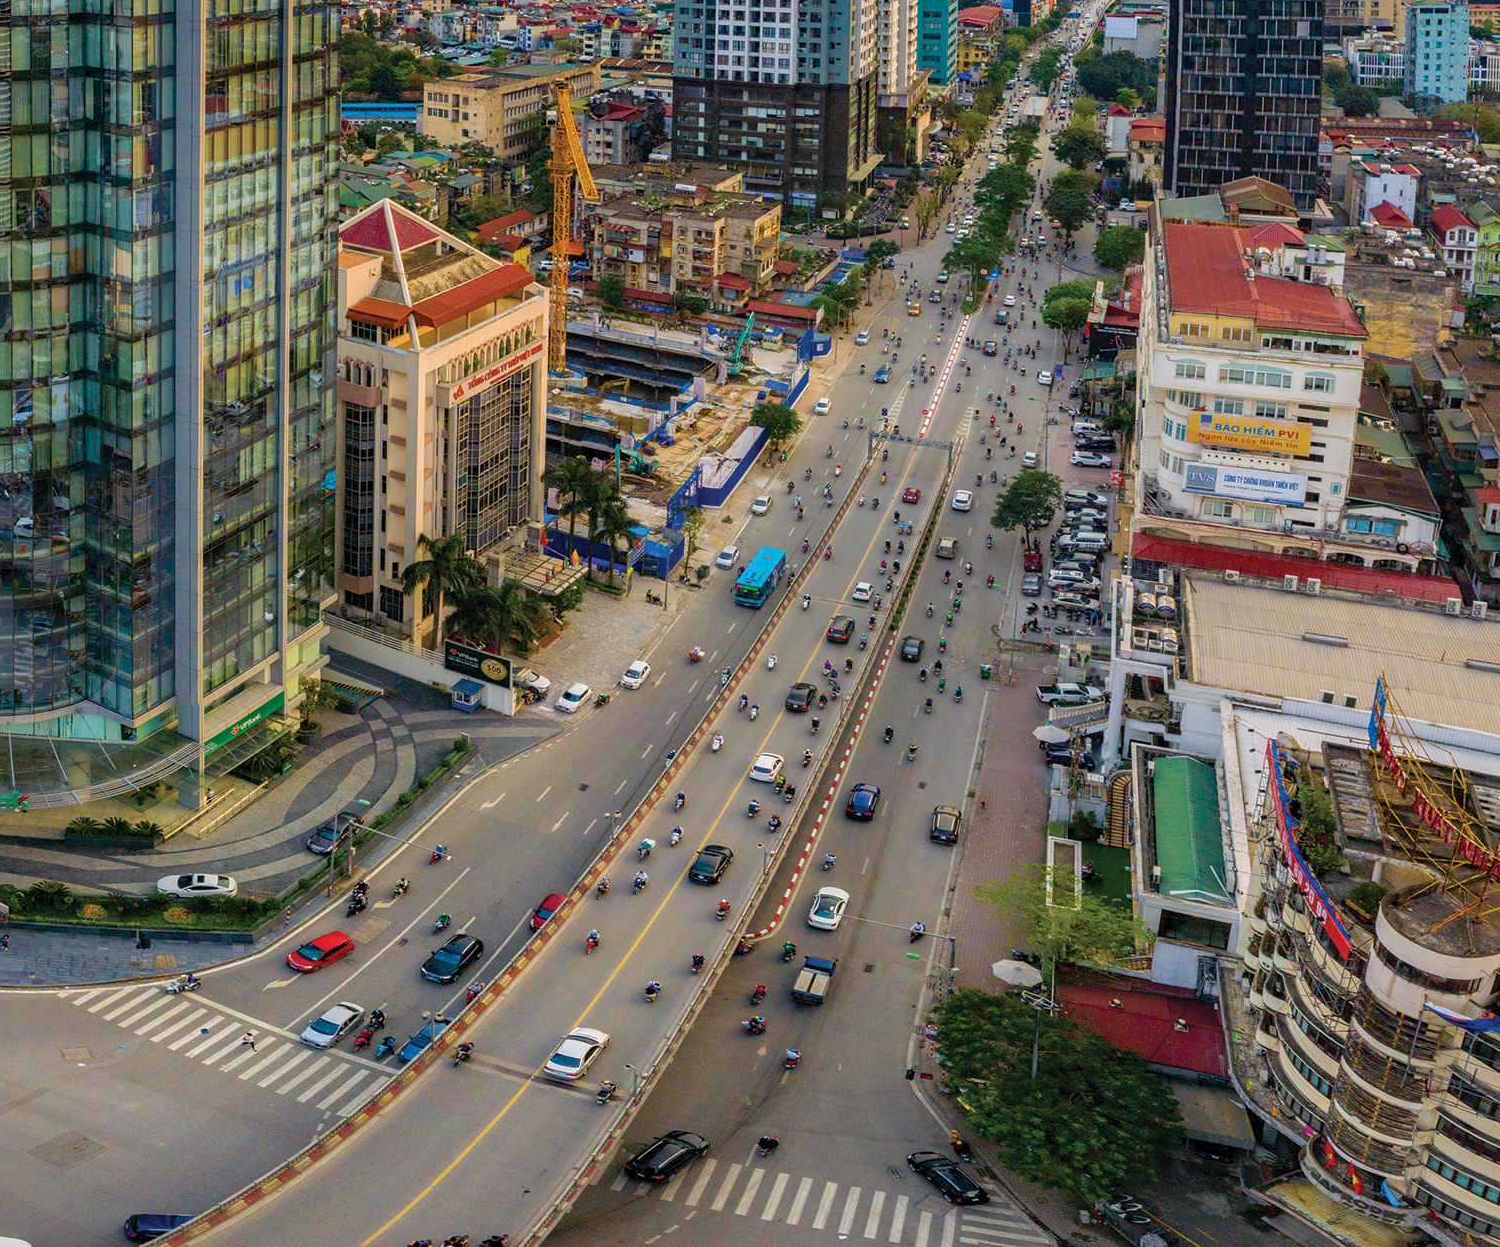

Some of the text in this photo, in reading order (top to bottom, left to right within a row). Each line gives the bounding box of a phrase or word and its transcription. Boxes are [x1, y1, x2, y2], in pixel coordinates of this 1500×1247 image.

[468, 375, 485, 390] TỔNG
[484, 369, 501, 381] CÔNG
[1215, 422, 1299, 440] BẢO HIỂM PVI
[1198, 432, 1222, 442] Ngọn
[1225, 433, 1238, 443] lửa
[1241, 436, 1256, 445] của
[1260, 438, 1283, 448] Niềm
[1189, 471, 1215, 483] TVS
[1224, 473, 1299, 491] CÔNG TY CHỨNG KHOÁN THIÊN VIỆT
[487, 664, 501, 674] 500
